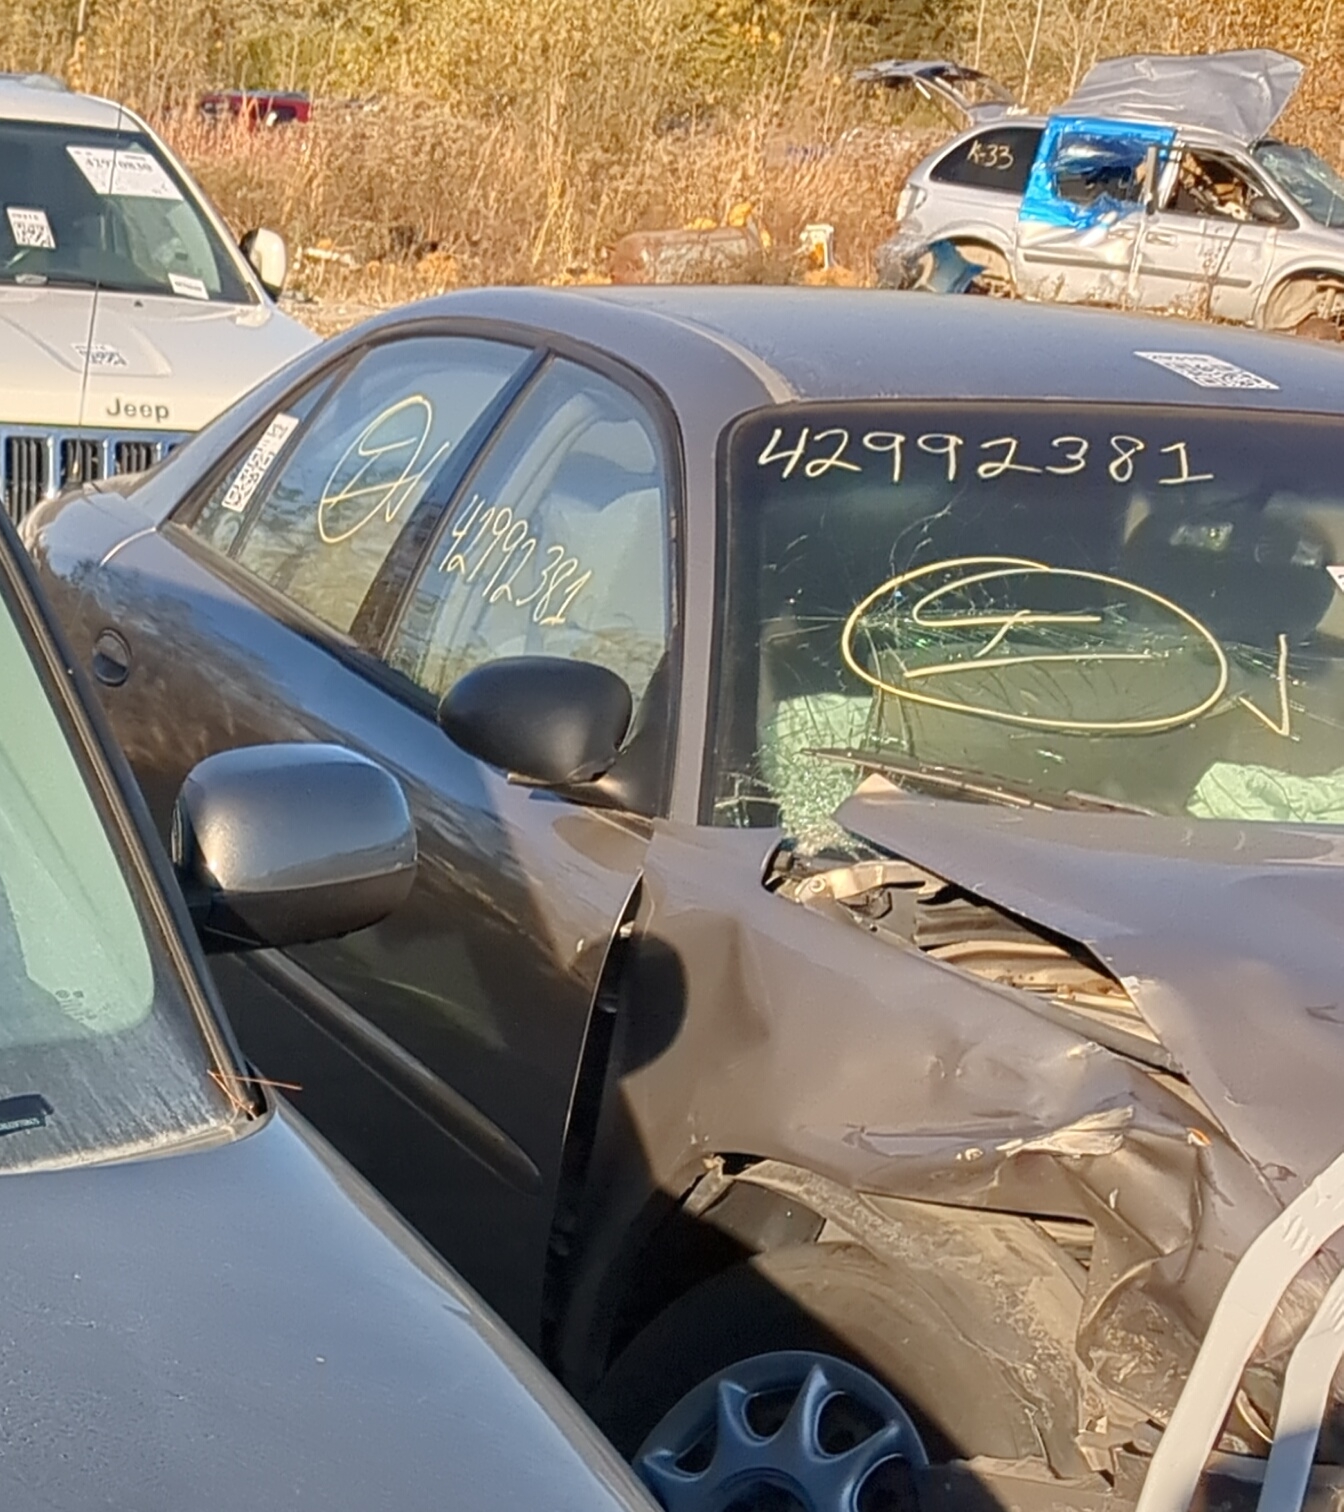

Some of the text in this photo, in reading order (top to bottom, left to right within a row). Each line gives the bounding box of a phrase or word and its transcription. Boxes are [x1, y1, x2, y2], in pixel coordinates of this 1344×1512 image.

[966, 139, 1015, 171] K-33
[106, 398, 170, 423] Jeep
[757, 426, 1214, 485] 42992381
[438, 493, 593, 626] 42992381
